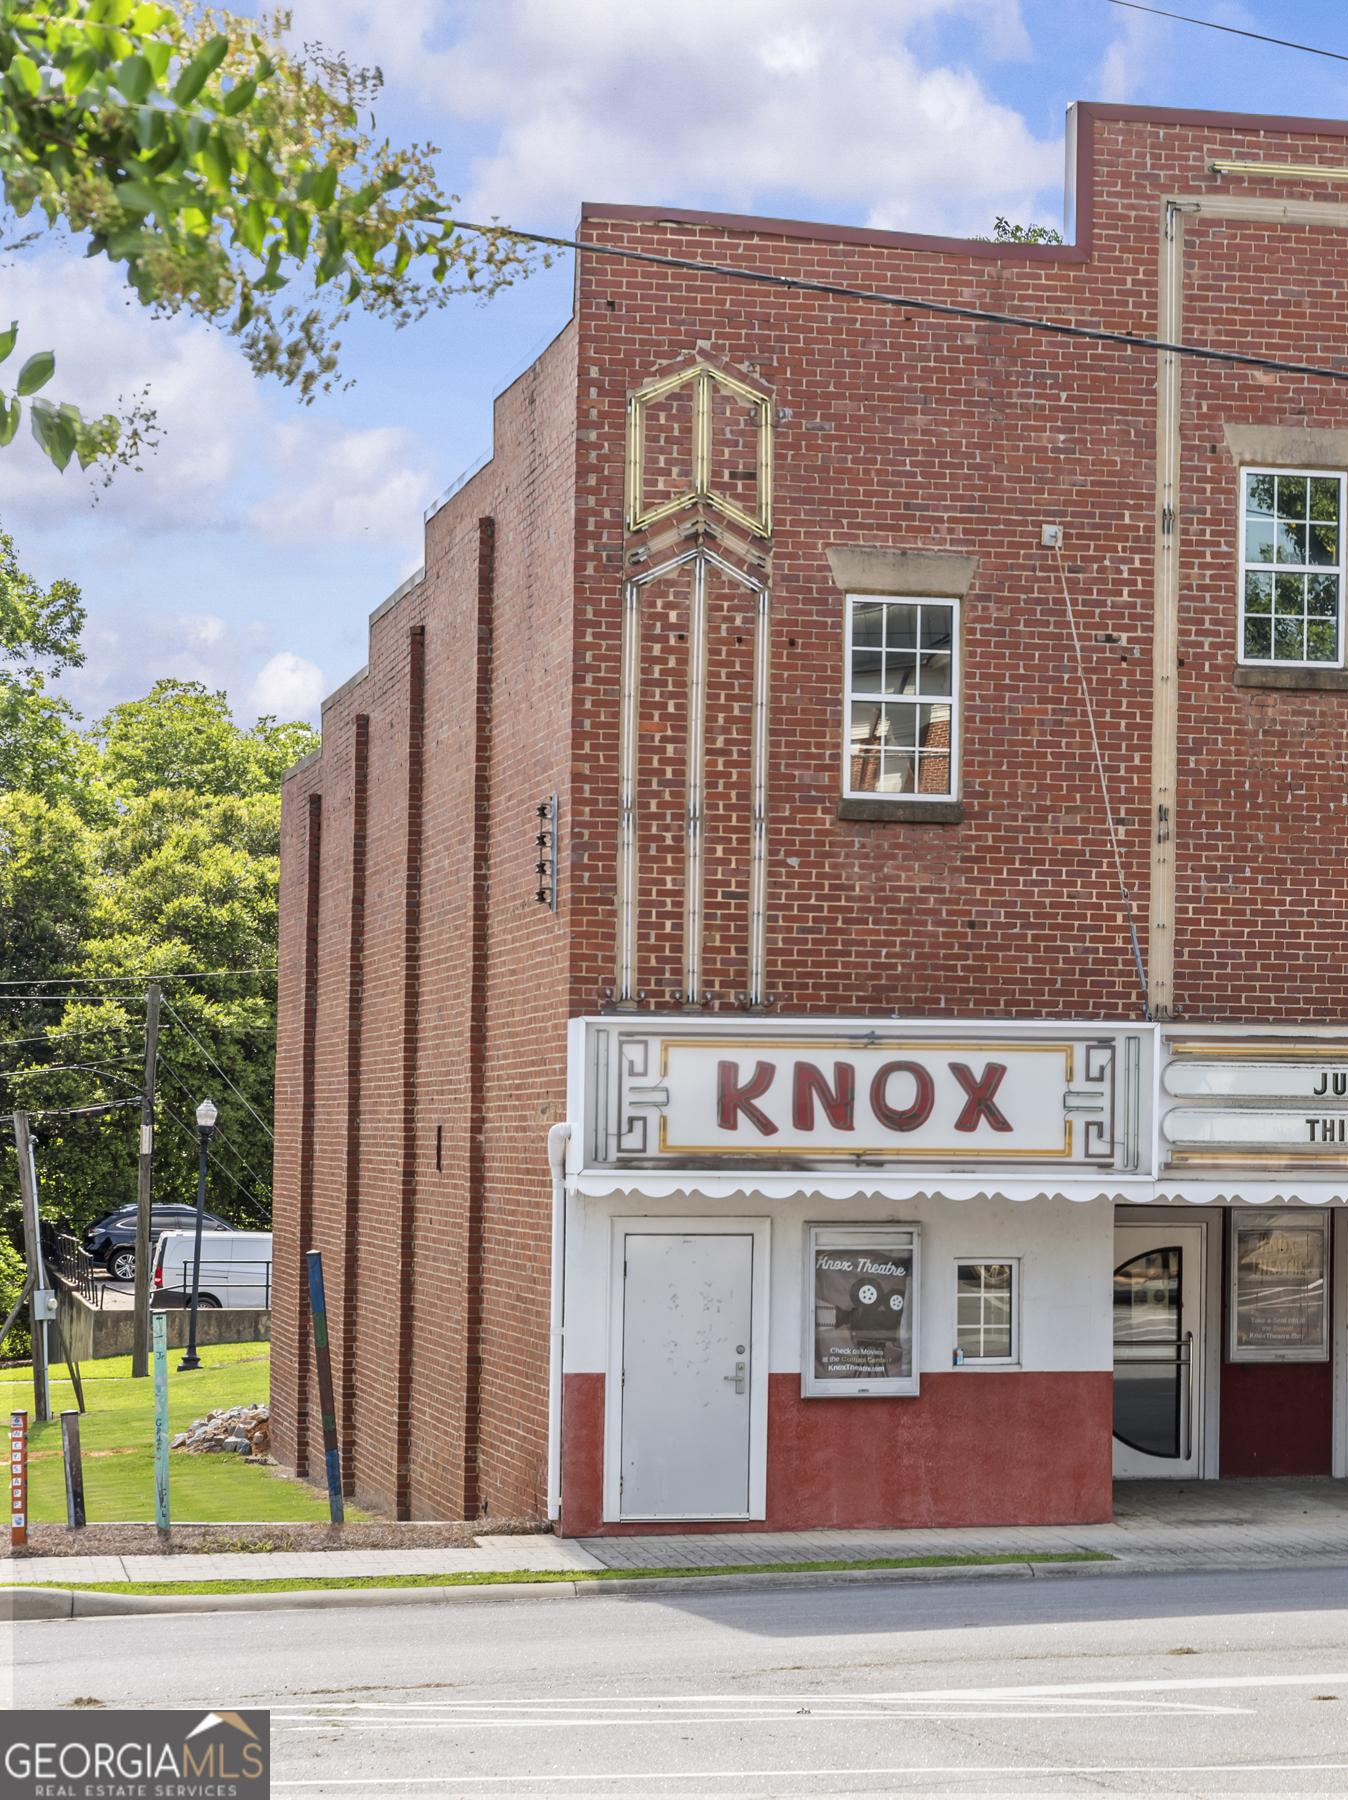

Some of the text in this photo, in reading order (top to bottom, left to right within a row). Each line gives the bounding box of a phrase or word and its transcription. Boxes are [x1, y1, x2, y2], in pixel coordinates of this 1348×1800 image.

[717, 1060, 1014, 1136] KNOX
[816, 1256, 906, 1276] Knox Theatre
[830, 1347, 851, 1355] Check
